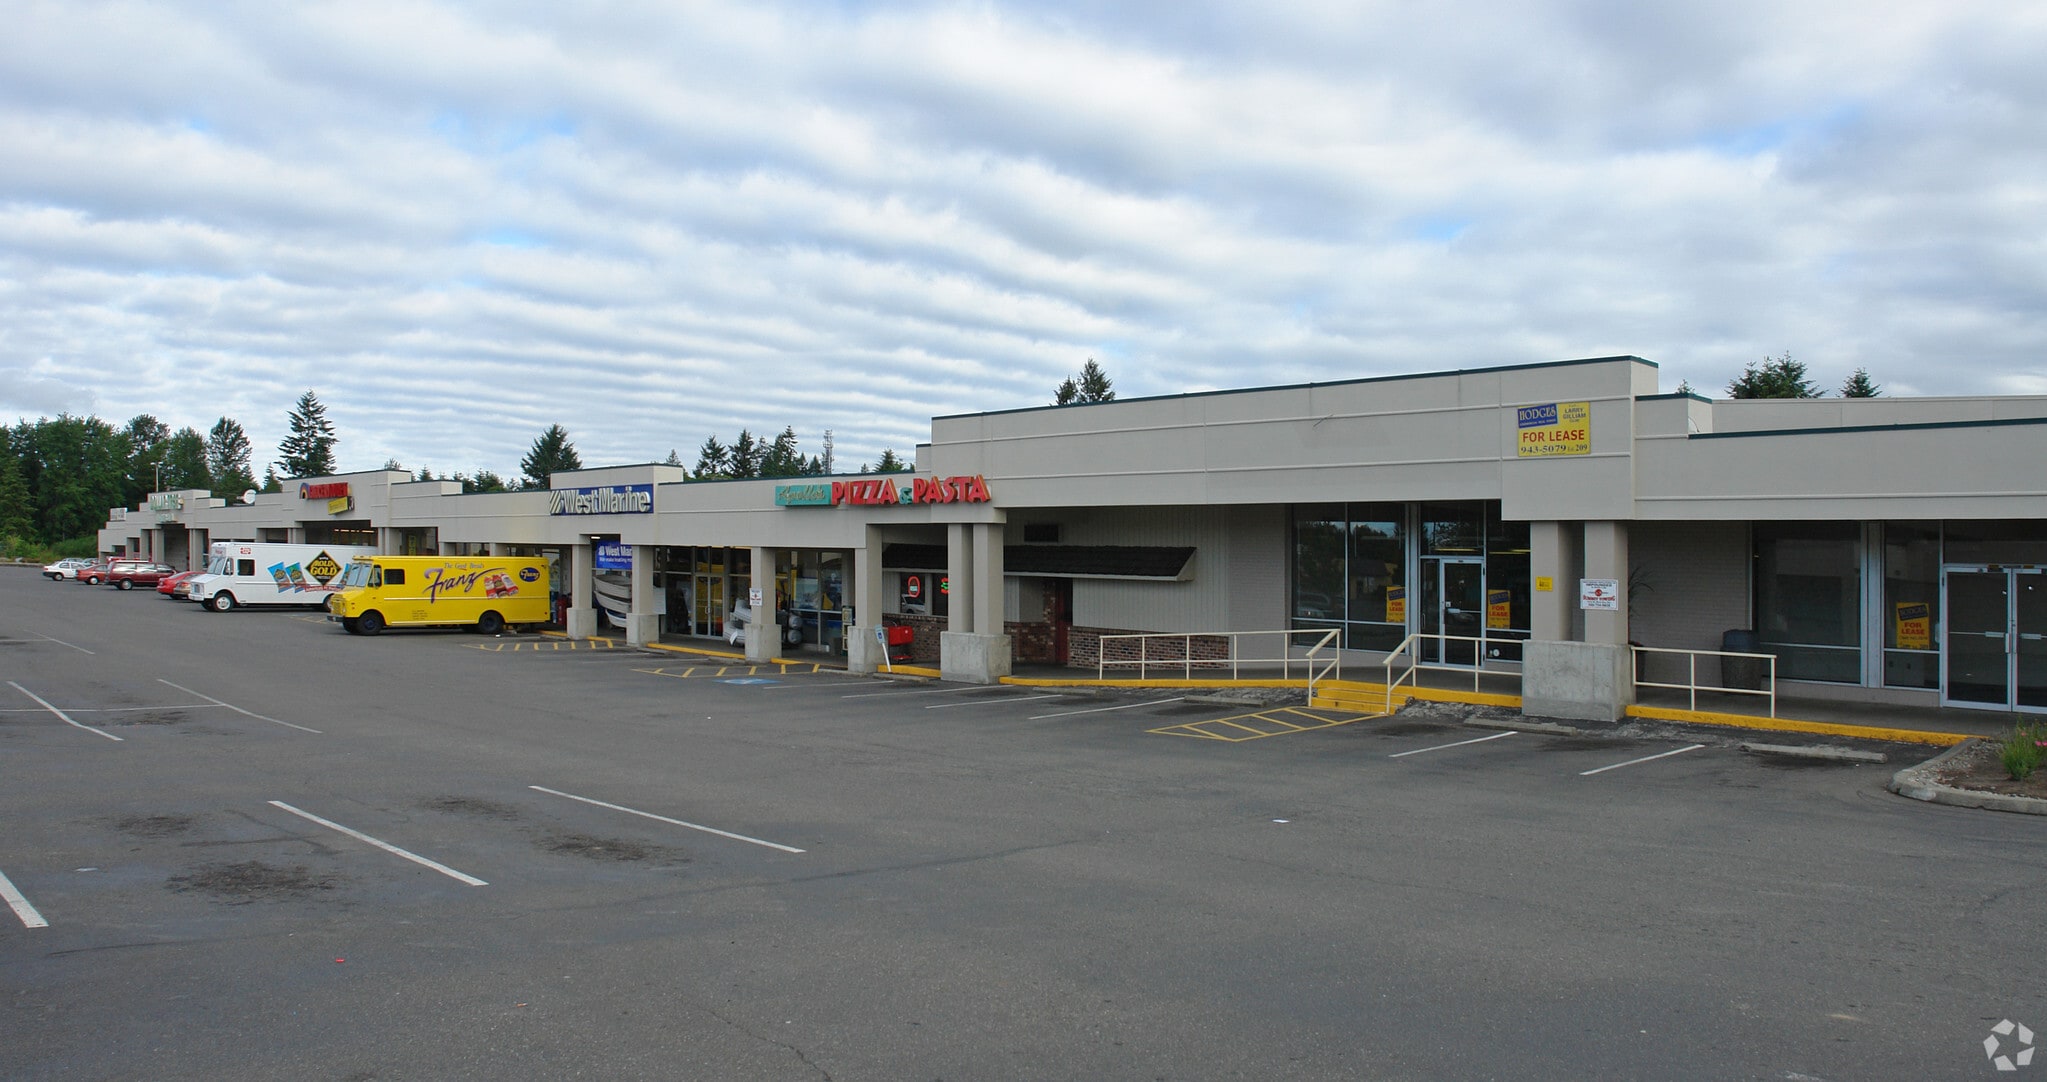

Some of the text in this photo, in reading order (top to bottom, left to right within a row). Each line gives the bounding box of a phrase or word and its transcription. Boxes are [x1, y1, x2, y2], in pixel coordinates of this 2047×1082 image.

[1519, 406, 1556, 421] HODGES
[1523, 430, 1585, 443] FOR LEASE
[1521, 444, 1566, 454] 943-5079
[1575, 443, 1588, 452] 209
[831, 477, 899, 506] PIZZA
[899, 487, 913, 505] &
[913, 474, 991, 505] PASTA
[562, 485, 651, 514] West Marine
[605, 545, 620, 556] West
[310, 566, 337, 576] GOLD
[422, 567, 505, 604] Franz
